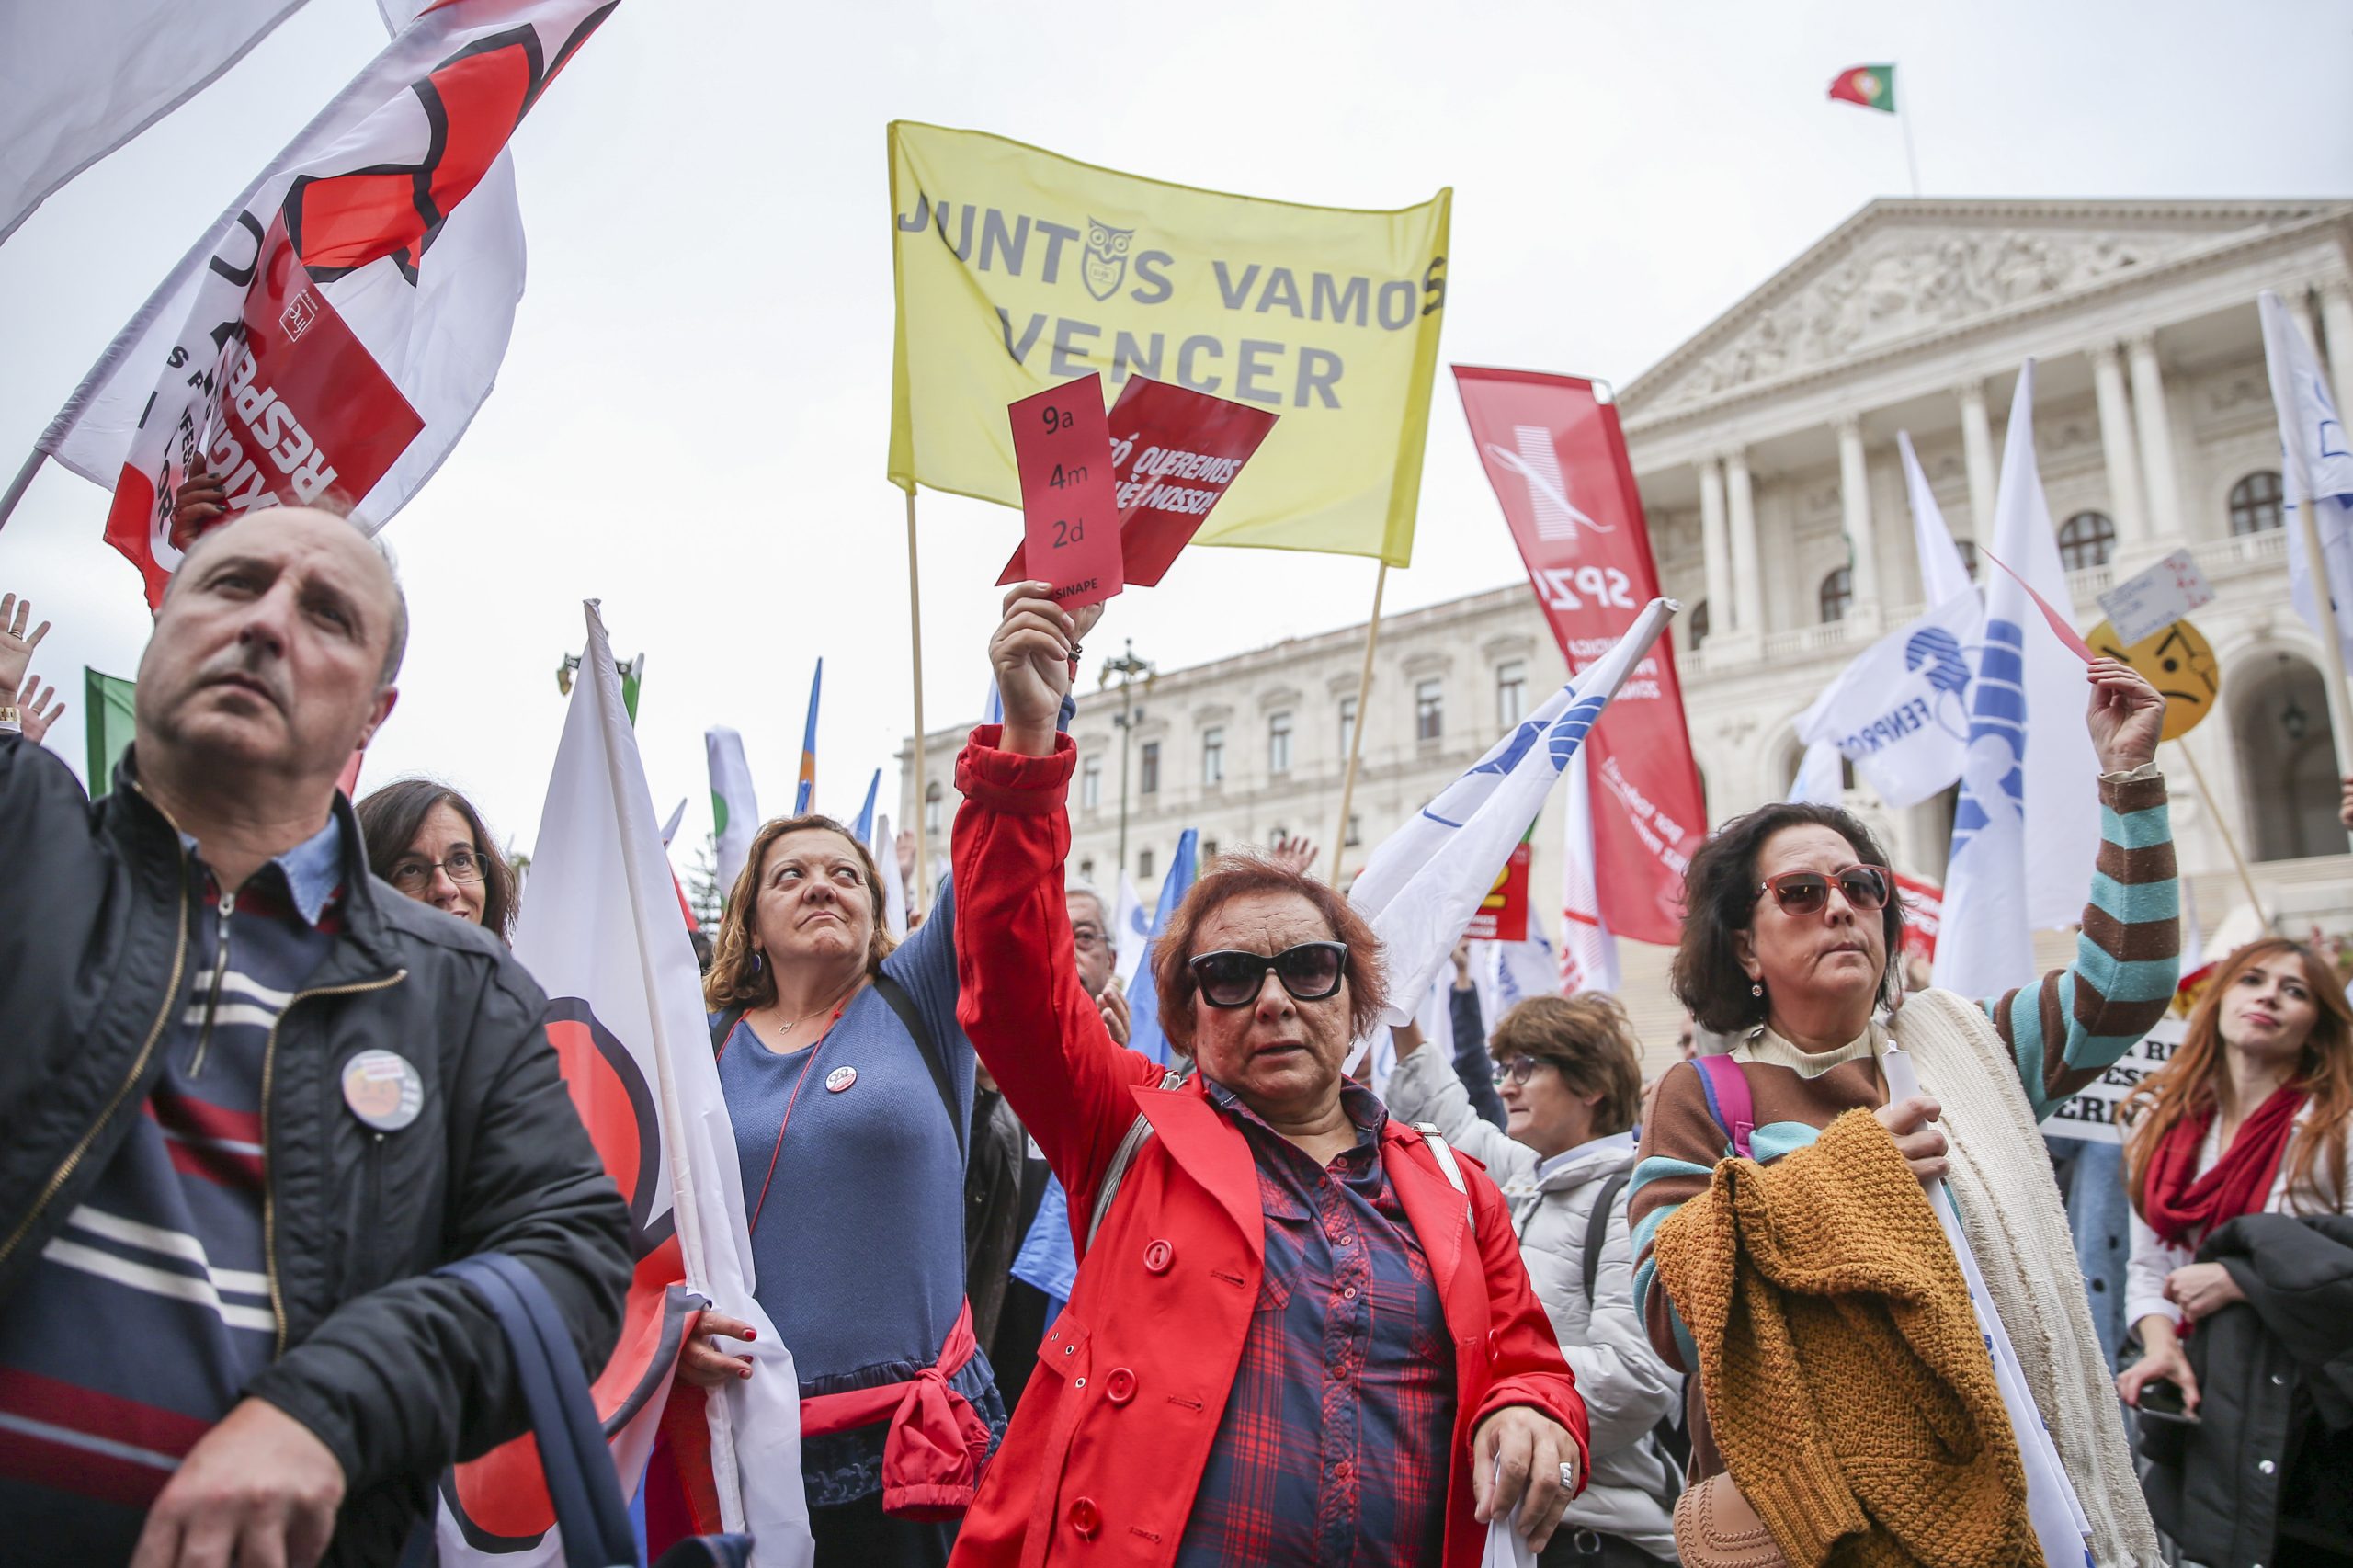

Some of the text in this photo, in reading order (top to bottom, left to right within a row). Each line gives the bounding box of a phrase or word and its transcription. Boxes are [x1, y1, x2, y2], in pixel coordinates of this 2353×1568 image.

[1211, 256, 1446, 332] VAMOS
[995, 305, 1344, 410] VENCER
[228, 349, 338, 506] RESPE
[1042, 405, 1074, 435] 9a
[1049, 463, 1087, 490] 4m
[1131, 446, 1243, 484] QUEREMOS
[1140, 483, 1221, 515] NOSSO!
[1052, 517, 1084, 549] 2d
[1055, 578, 1098, 599] SINAPE
